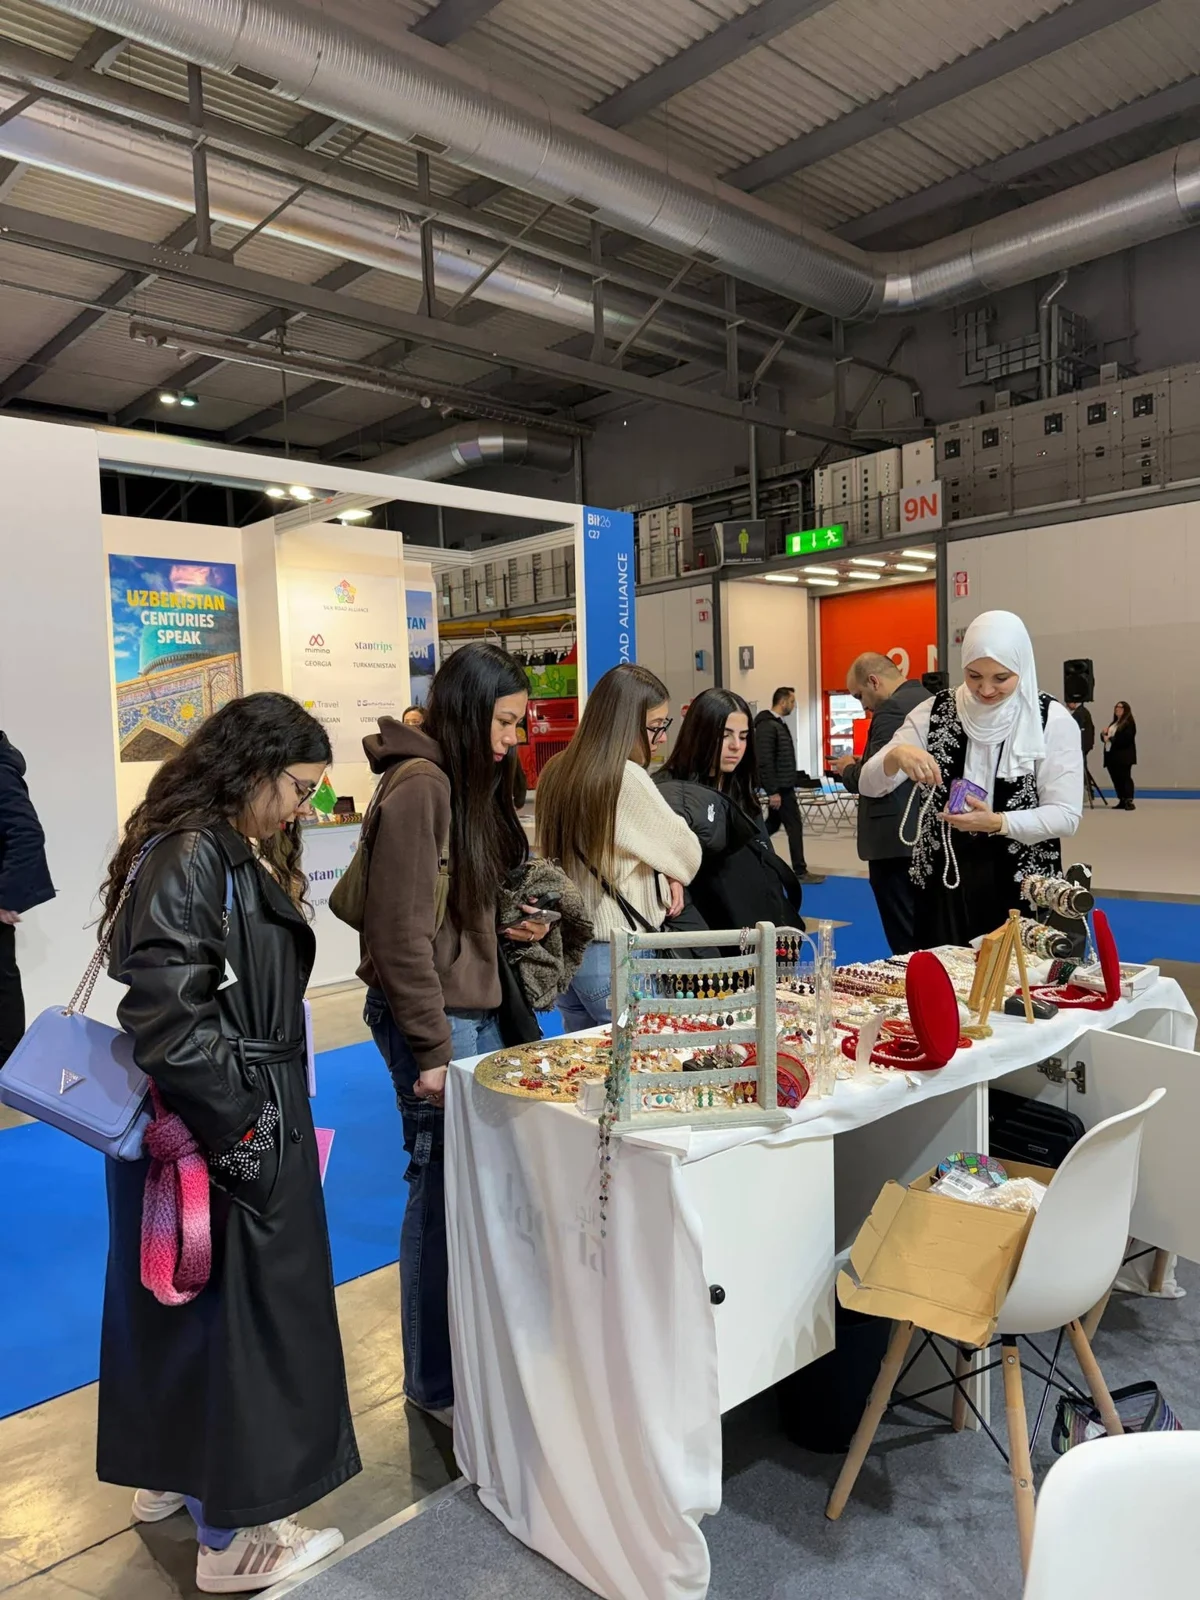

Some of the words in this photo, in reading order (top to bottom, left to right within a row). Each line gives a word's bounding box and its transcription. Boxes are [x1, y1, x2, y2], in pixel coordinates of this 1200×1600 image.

[904, 493, 938, 522] 9N
[617, 552, 629, 628] ALLIANCE
[126, 590, 226, 610] UZBEKISTAN
[140, 610, 215, 628] CENTURIES
[407, 616, 426, 630] TAN
[157, 629, 202, 645] SPEAK
[354, 641, 393, 654] stantrips
[619, 632, 630, 665] OAD
[353, 661, 396, 669] TURKMENISTAN
[318, 700, 339, 708] Travel
